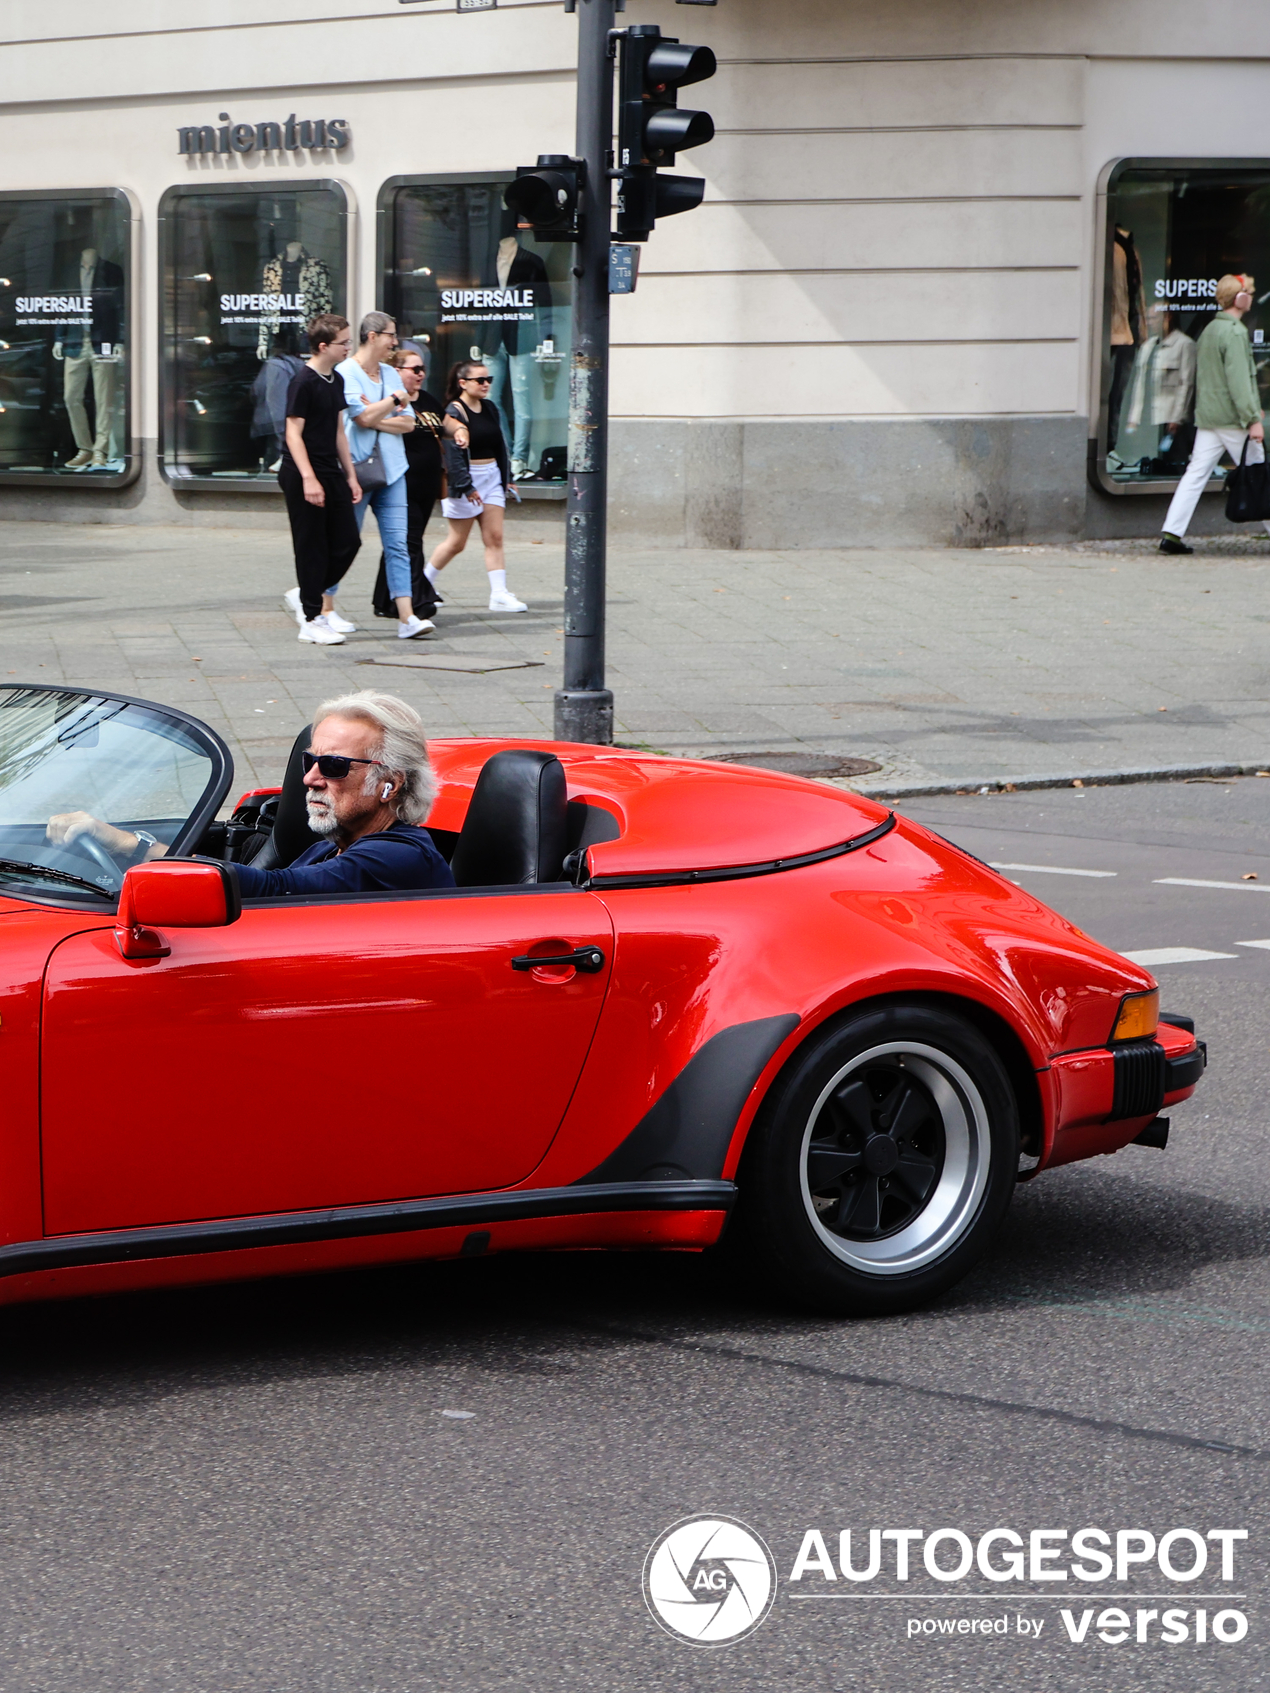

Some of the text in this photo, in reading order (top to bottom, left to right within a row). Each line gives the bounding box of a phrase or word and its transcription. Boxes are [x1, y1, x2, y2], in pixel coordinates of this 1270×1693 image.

[176, 112, 348, 155] mientus
[1154, 279, 1218, 298] SUPERS
[15, 296, 94, 313] SUPERSALE
[220, 294, 305, 311] SUPERSALE
[441, 290, 534, 308] SUPERSALE
